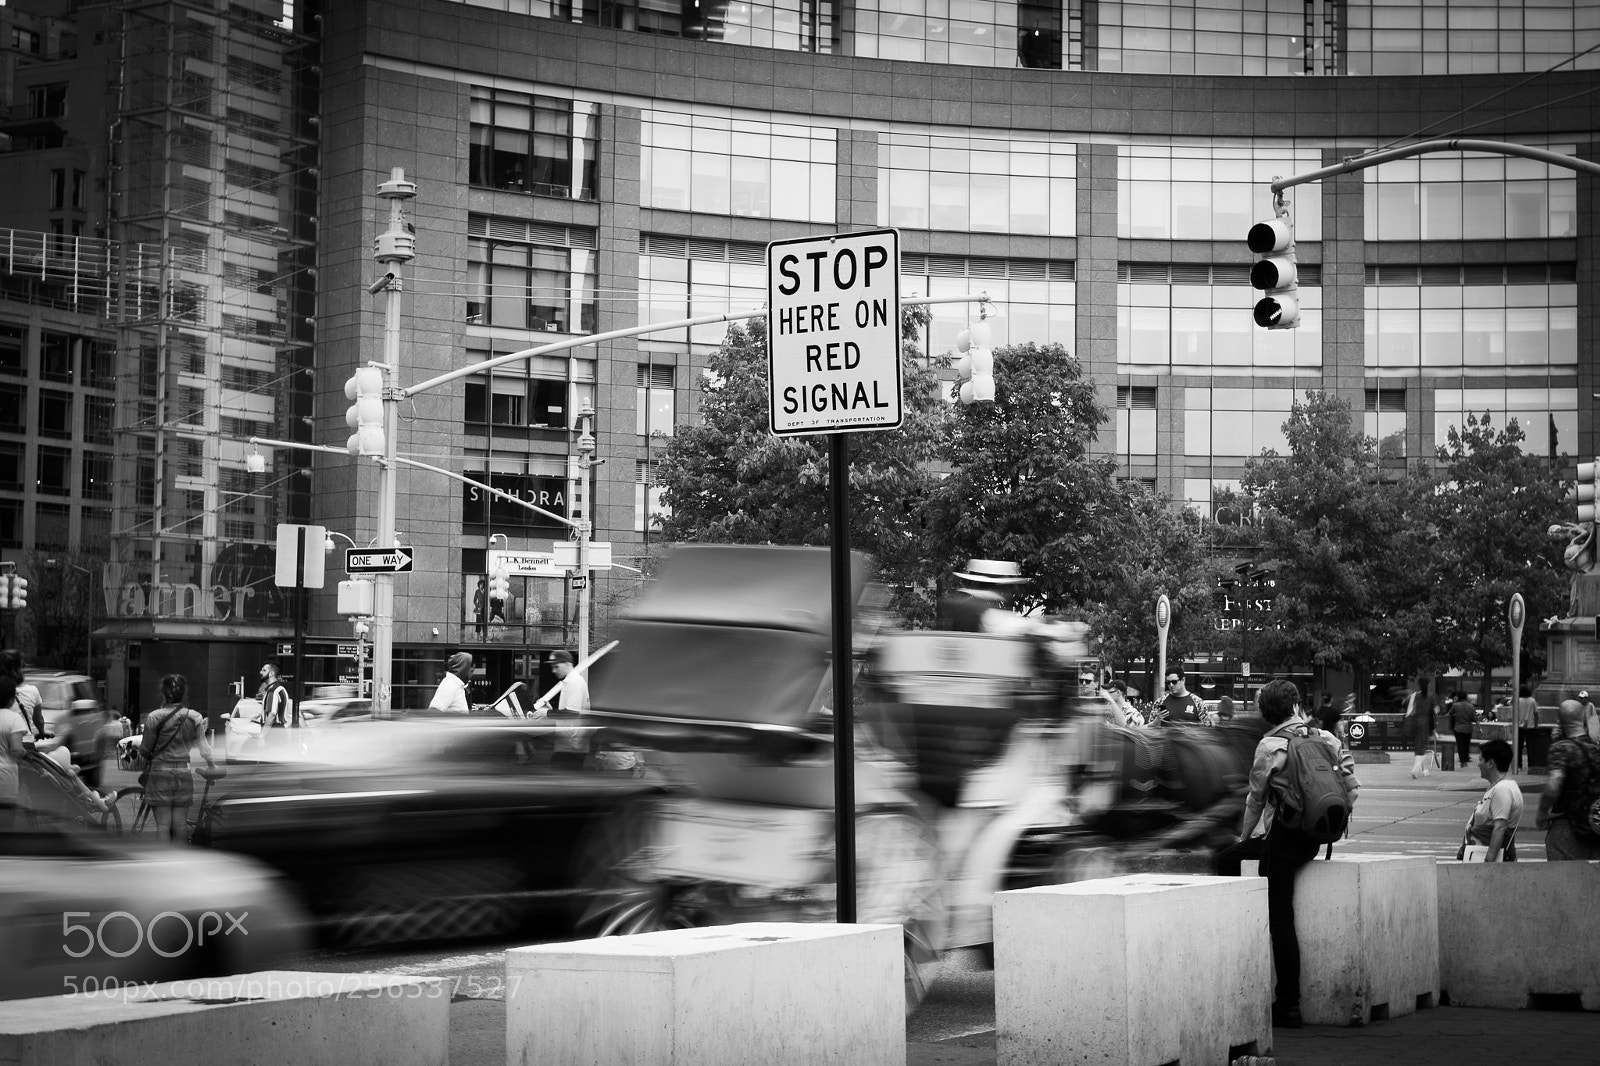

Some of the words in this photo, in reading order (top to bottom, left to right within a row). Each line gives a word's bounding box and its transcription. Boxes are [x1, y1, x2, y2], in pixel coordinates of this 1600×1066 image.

[778, 245, 888, 296] STOP
[780, 302, 840, 335] HERE
[855, 298, 887, 329] ON
[806, 341, 861, 373] RED
[783, 380, 889, 415] SIGNAL
[826, 416, 886, 424] TRANSPORTATION
[470, 486, 565, 506] SPHORA
[352, 555, 372, 566] ONE
[382, 554, 404, 565] WAY
